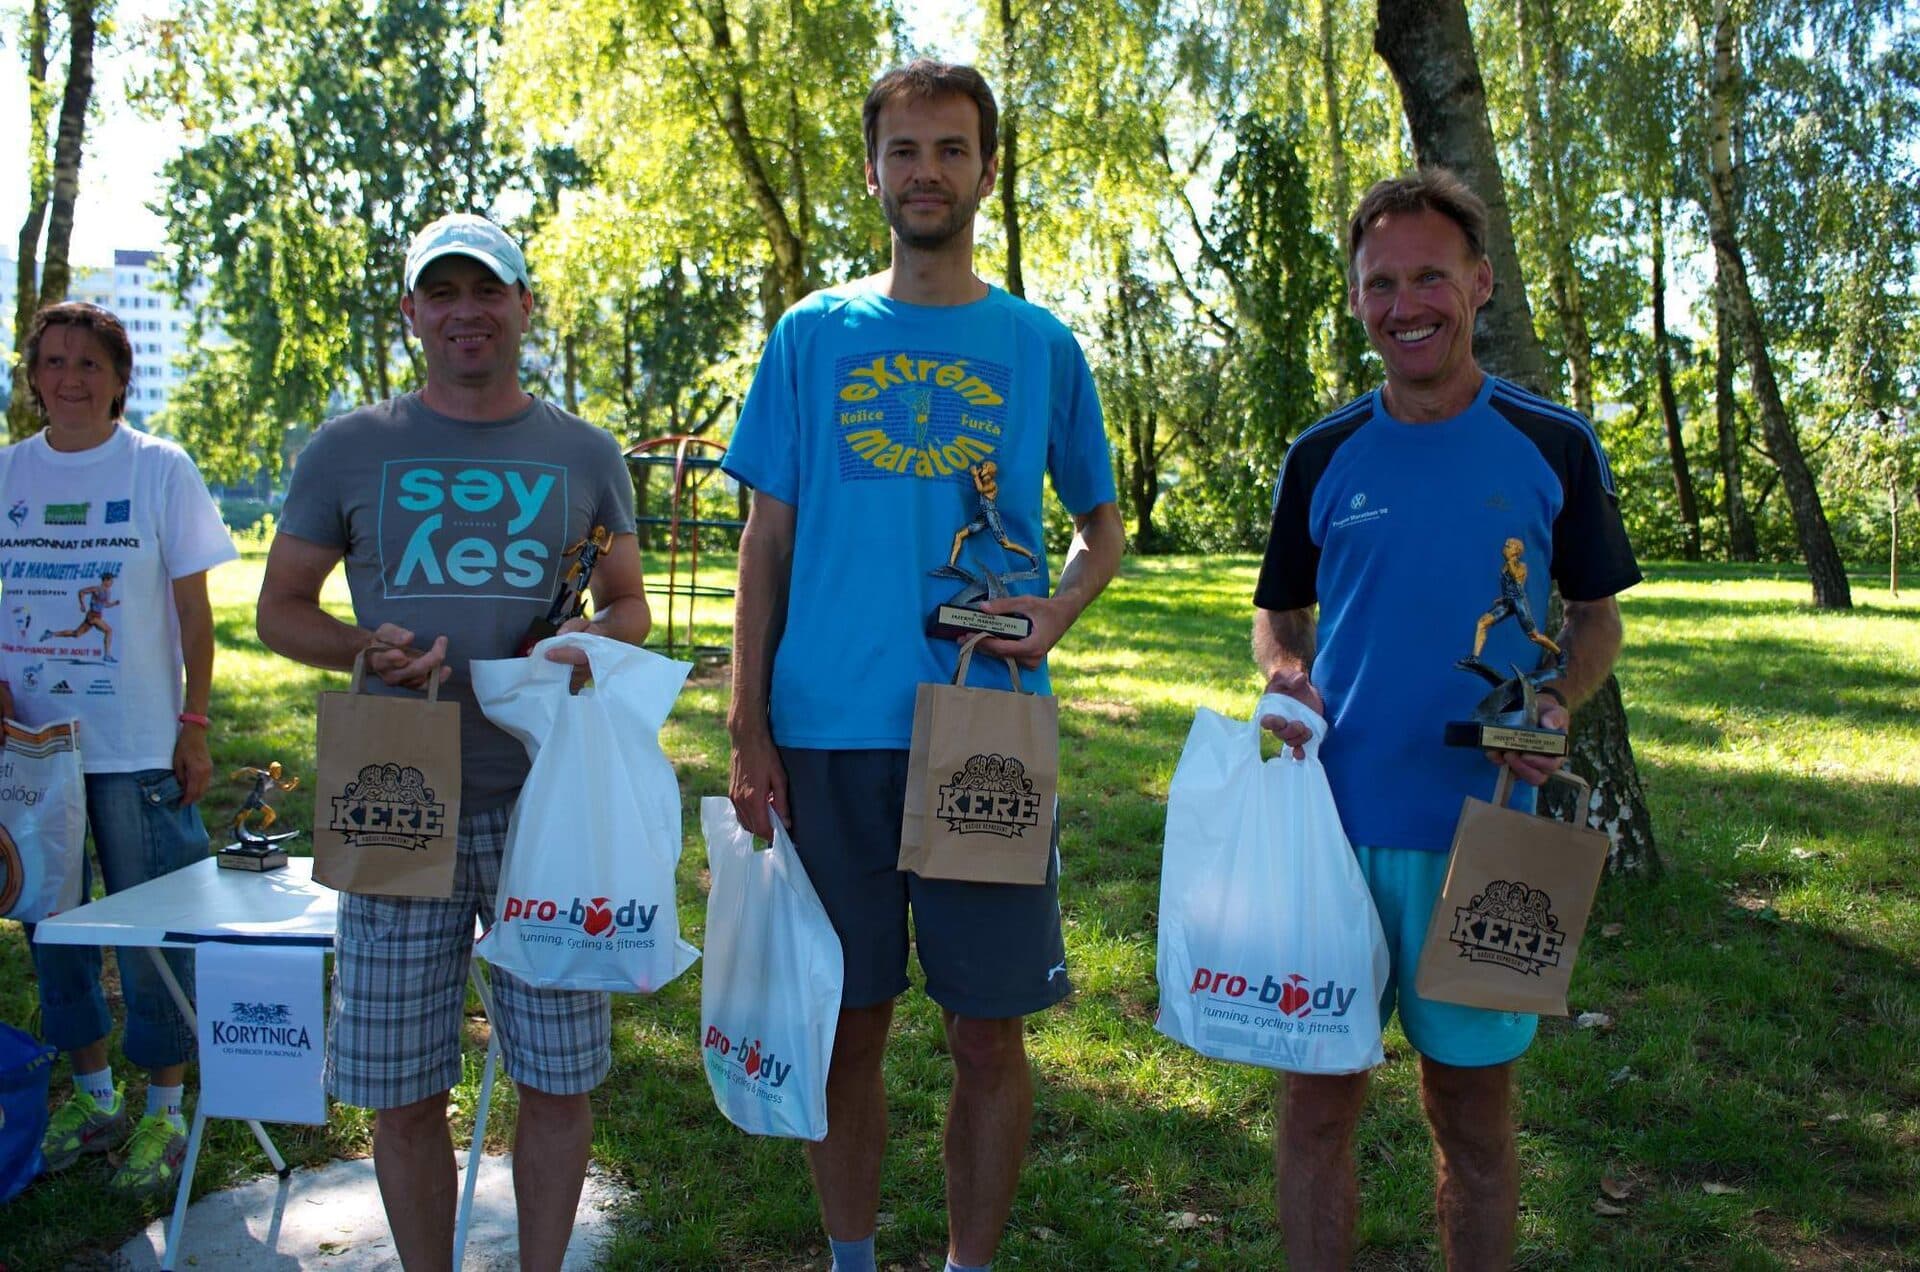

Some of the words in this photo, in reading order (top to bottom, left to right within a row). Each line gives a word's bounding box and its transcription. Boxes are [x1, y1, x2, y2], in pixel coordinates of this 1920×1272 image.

[839, 353, 1004, 406] extrém
[840, 410, 884, 426] Košice
[80, 539, 93, 549] DE
[95, 537, 140, 548] FRANCE
[330, 796, 445, 838] KERE
[937, 784, 1041, 825] KERE
[617, 938, 655, 952] fitness
[1449, 907, 1566, 967] KERE
[212, 1020, 312, 1050] KORYTNICA
[1254, 1016, 1294, 1033] cycling
[1296, 1021, 1305, 1032] &
[1308, 1020, 1349, 1035] fitness
